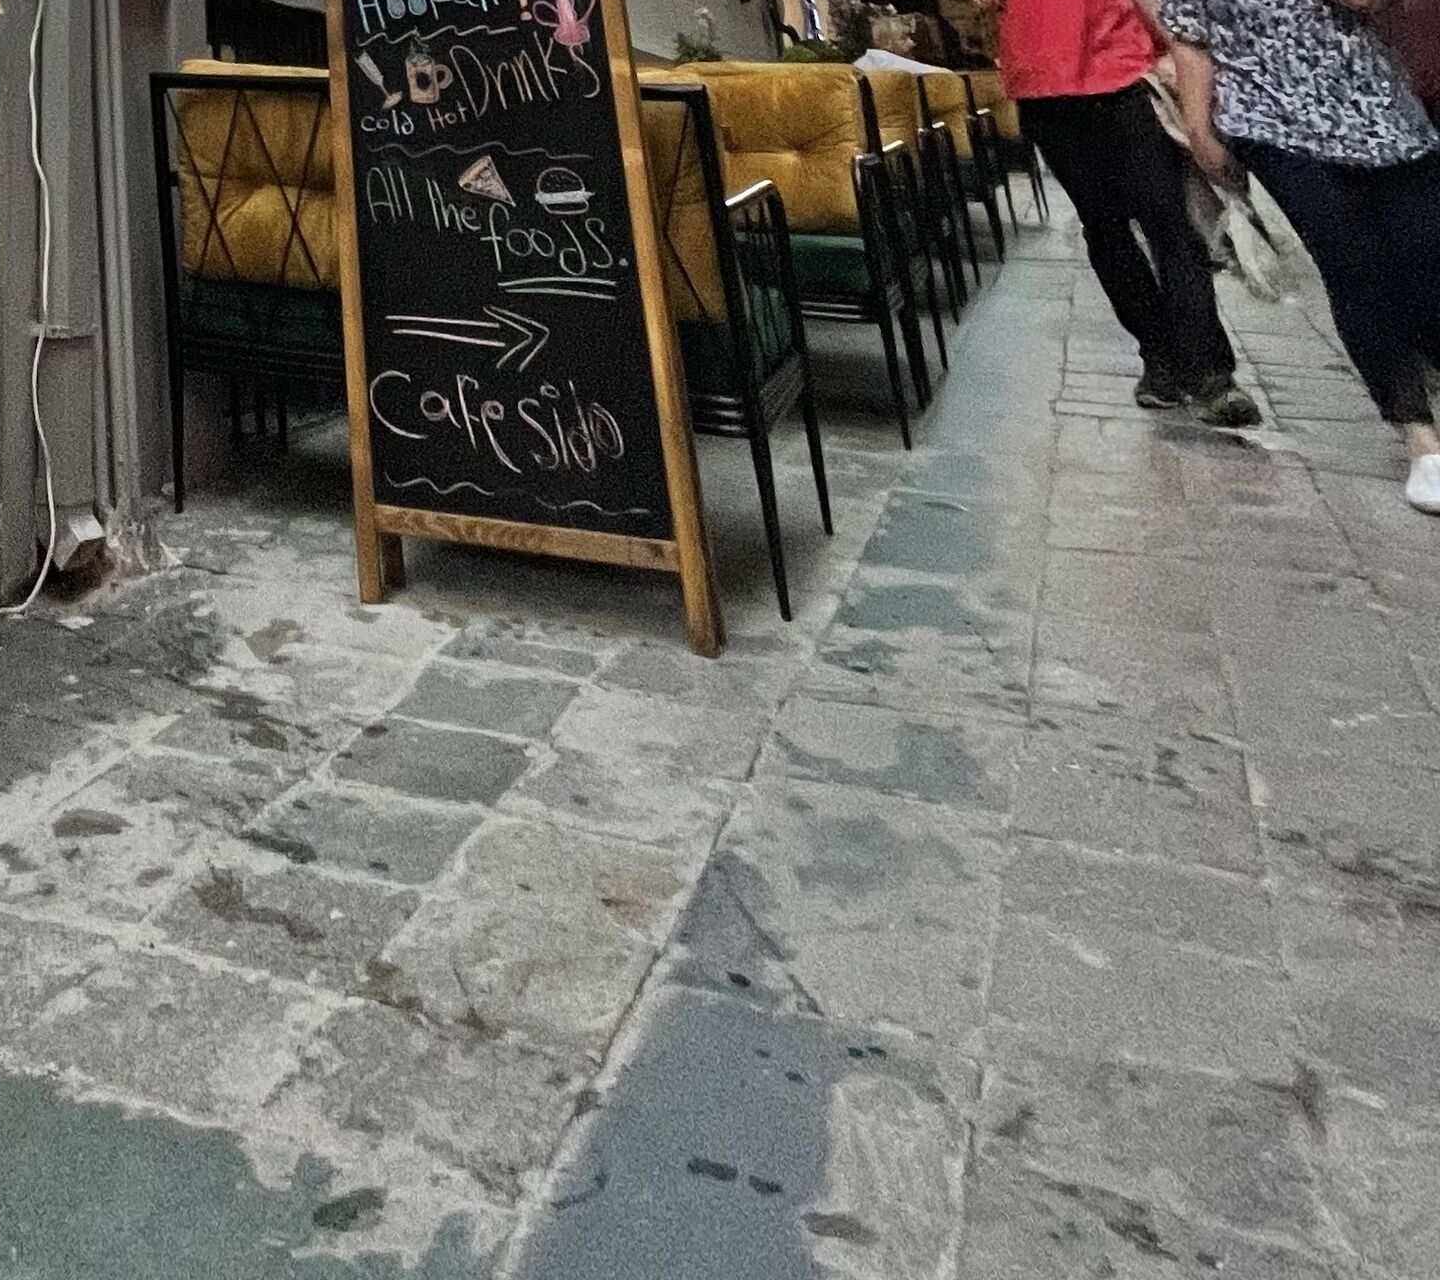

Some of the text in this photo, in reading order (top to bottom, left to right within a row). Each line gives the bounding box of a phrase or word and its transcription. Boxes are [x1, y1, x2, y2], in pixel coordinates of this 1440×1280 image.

[366, 166, 414, 223] All
[369, 370, 624, 473] Cafe Sido
